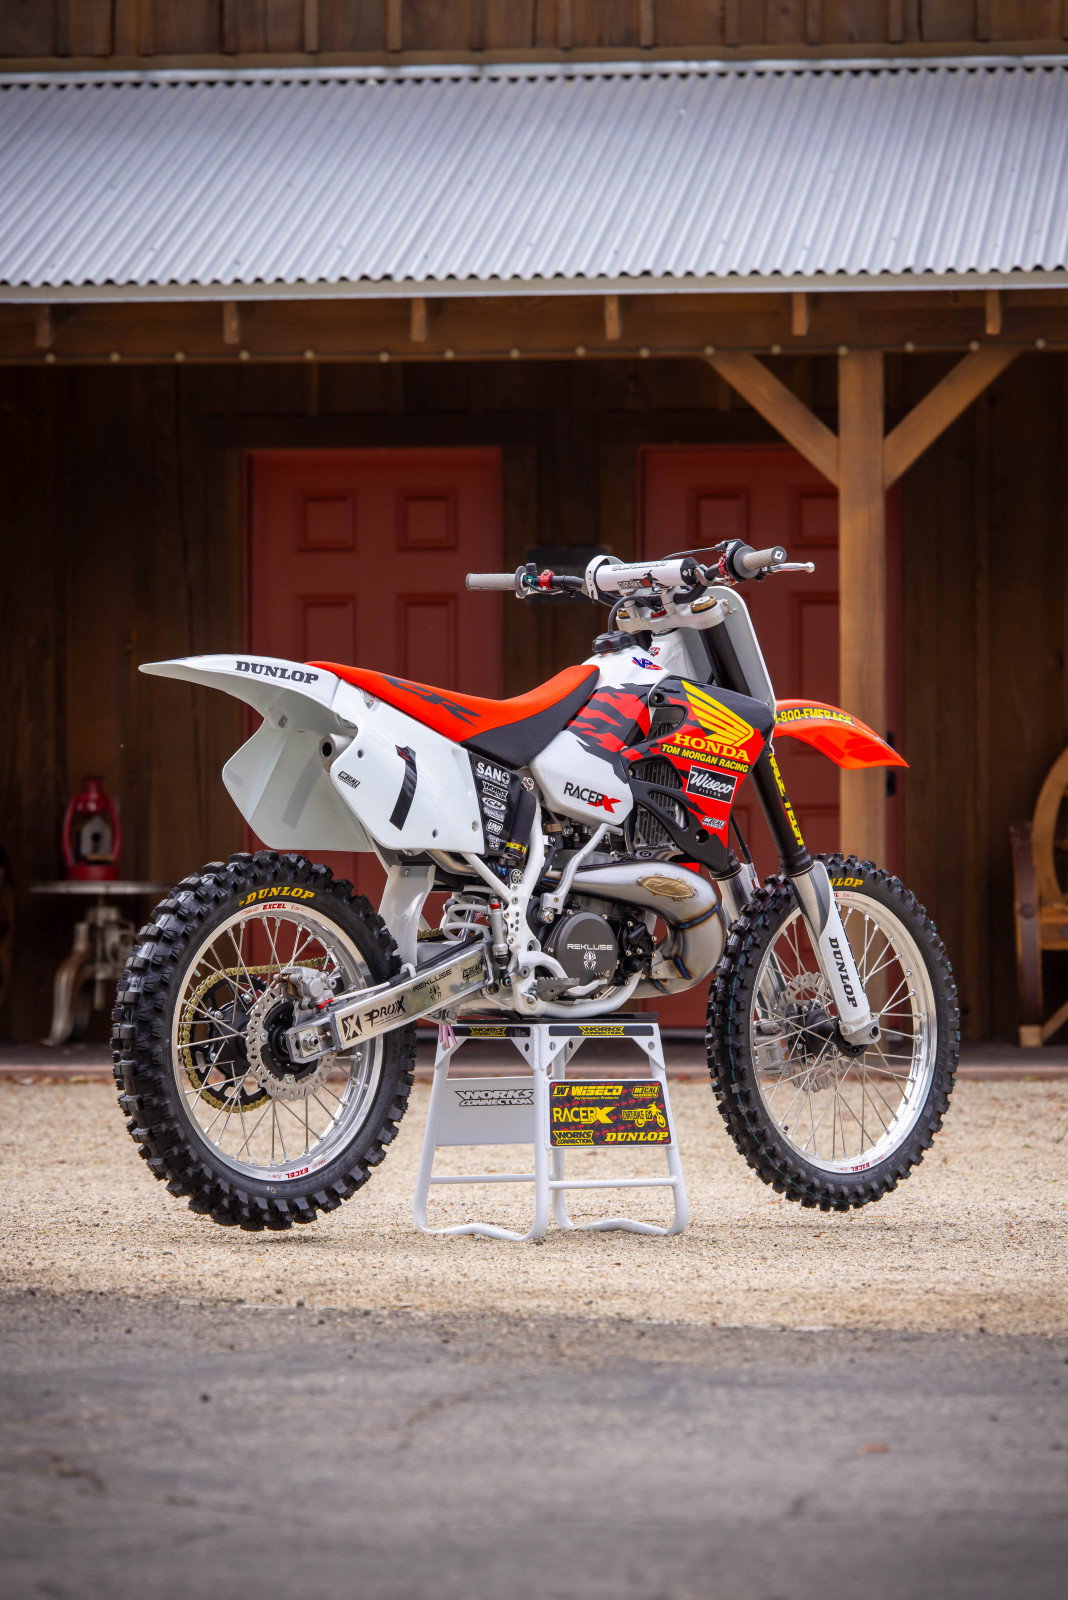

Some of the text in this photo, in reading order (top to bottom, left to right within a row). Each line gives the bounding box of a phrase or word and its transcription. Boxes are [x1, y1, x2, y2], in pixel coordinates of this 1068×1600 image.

[235, 660, 319, 684] DUNLOP
[673, 732, 750, 762] HONDA
[661, 743, 749, 773] TOM MORGAN RACING
[690, 770, 735, 794] Wiseco
[698, 788, 721, 797] PISTON
[245, 886, 315, 905] DUNLOP
[566, 943, 614, 951] REKLUSE
[828, 936, 858, 1008] DUNLOP
[412, 967, 453, 993] REKLUSE
[454, 1089, 534, 1100] WORKS
[459, 1099, 534, 1107] CONNECTION
[553, 1130, 594, 1139] WORKS
[604, 1131, 669, 1142] DUNLOP
[851, 1161, 871, 1171] EXCEL
[285, 1167, 309, 1179] EXCEL
